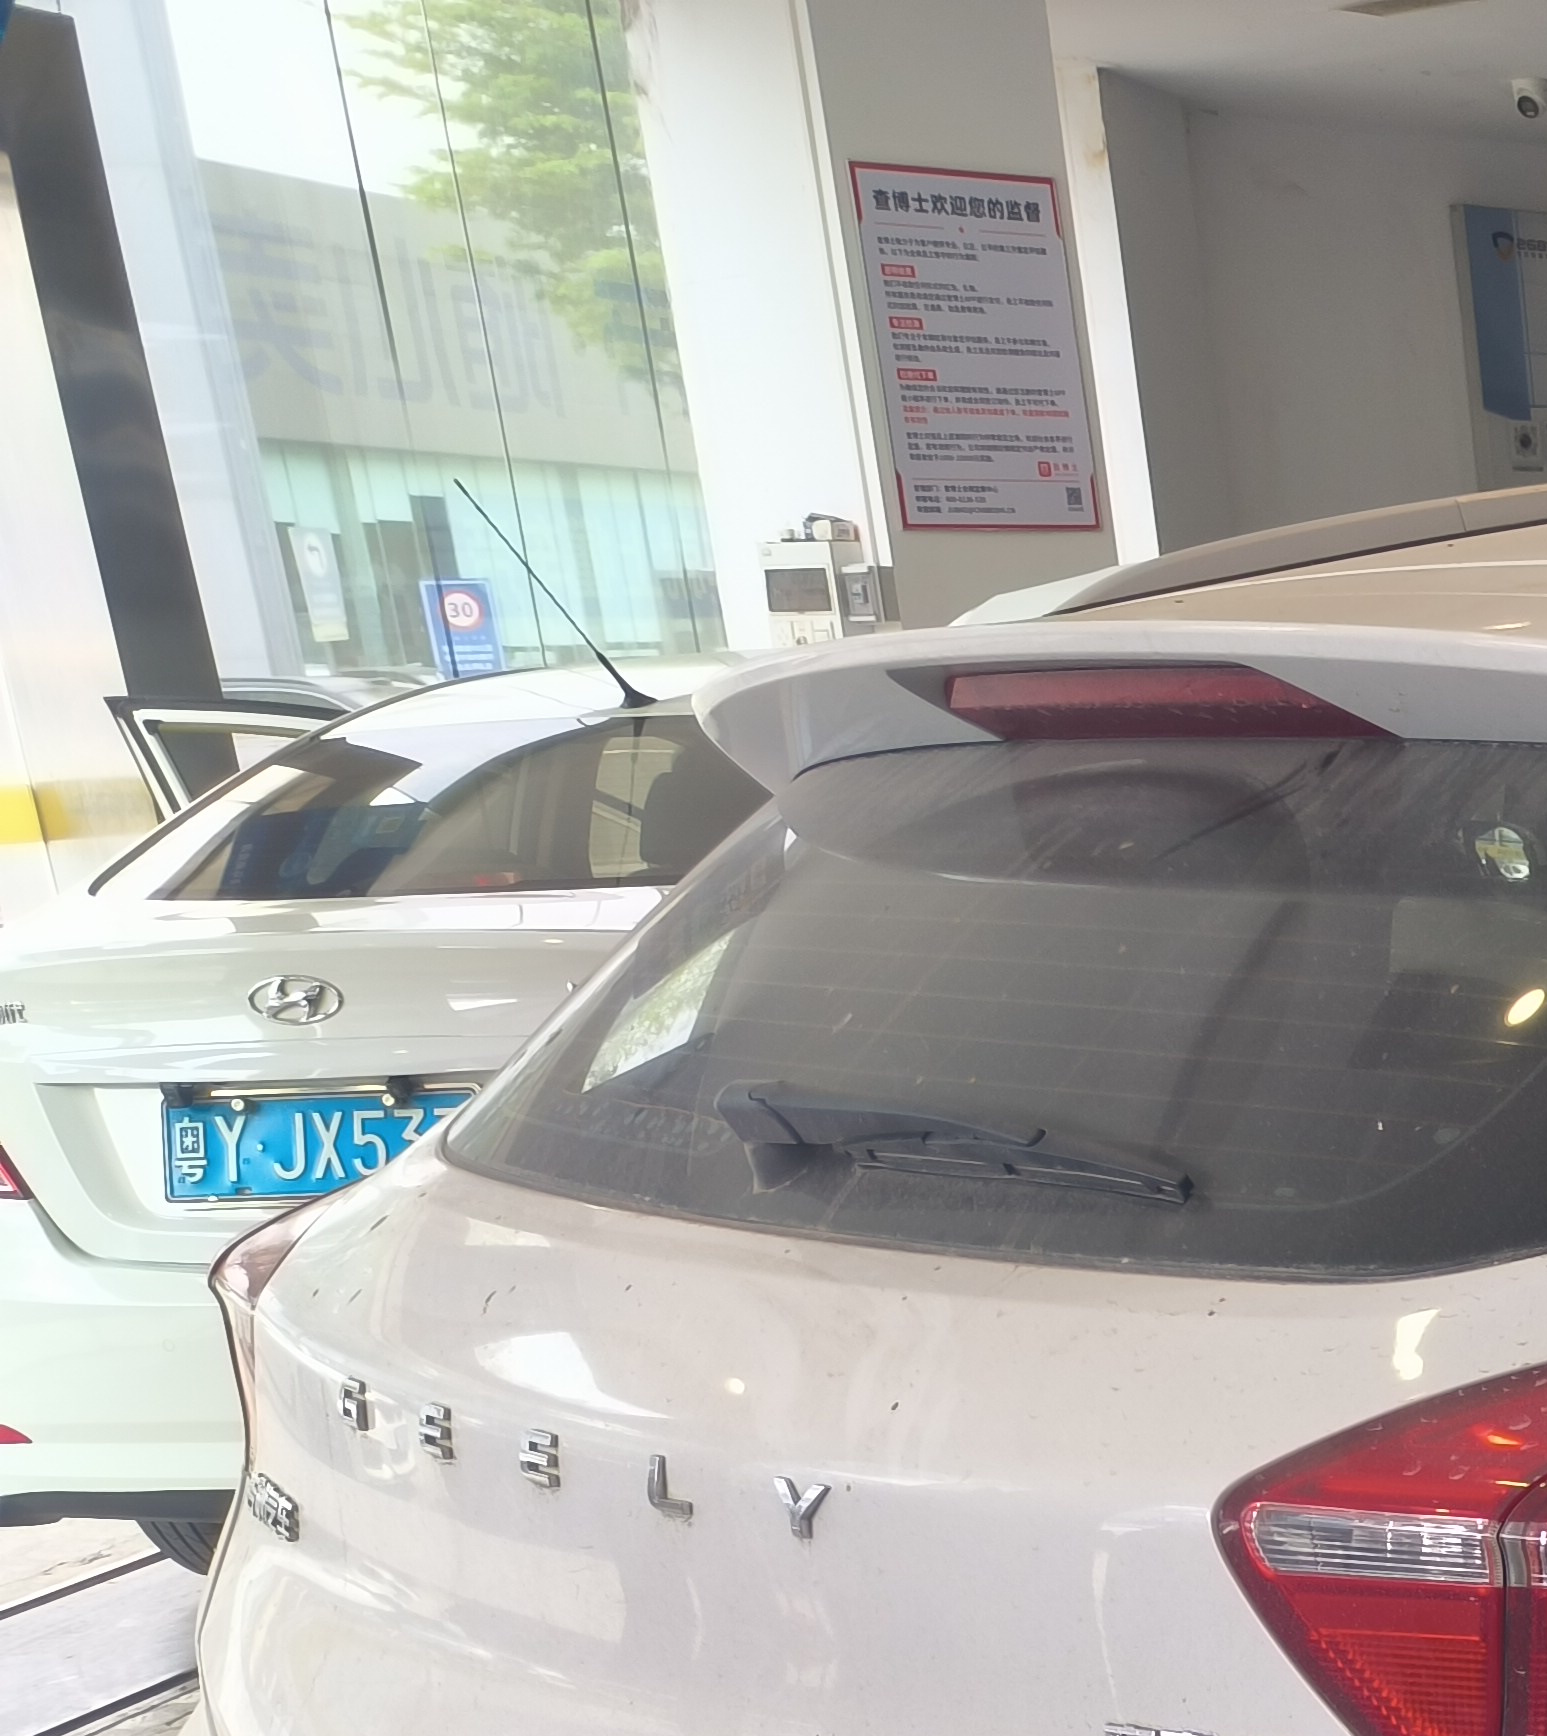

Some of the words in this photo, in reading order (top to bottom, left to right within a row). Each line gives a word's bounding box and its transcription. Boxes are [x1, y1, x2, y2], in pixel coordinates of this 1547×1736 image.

[872, 188, 1041, 223] 查博士欢迎您的监督
[447, 601, 474, 619] 30
[174, 1108, 457, 1184] 粤Y·JX53
[337, 1374, 832, 1542] GEELY
